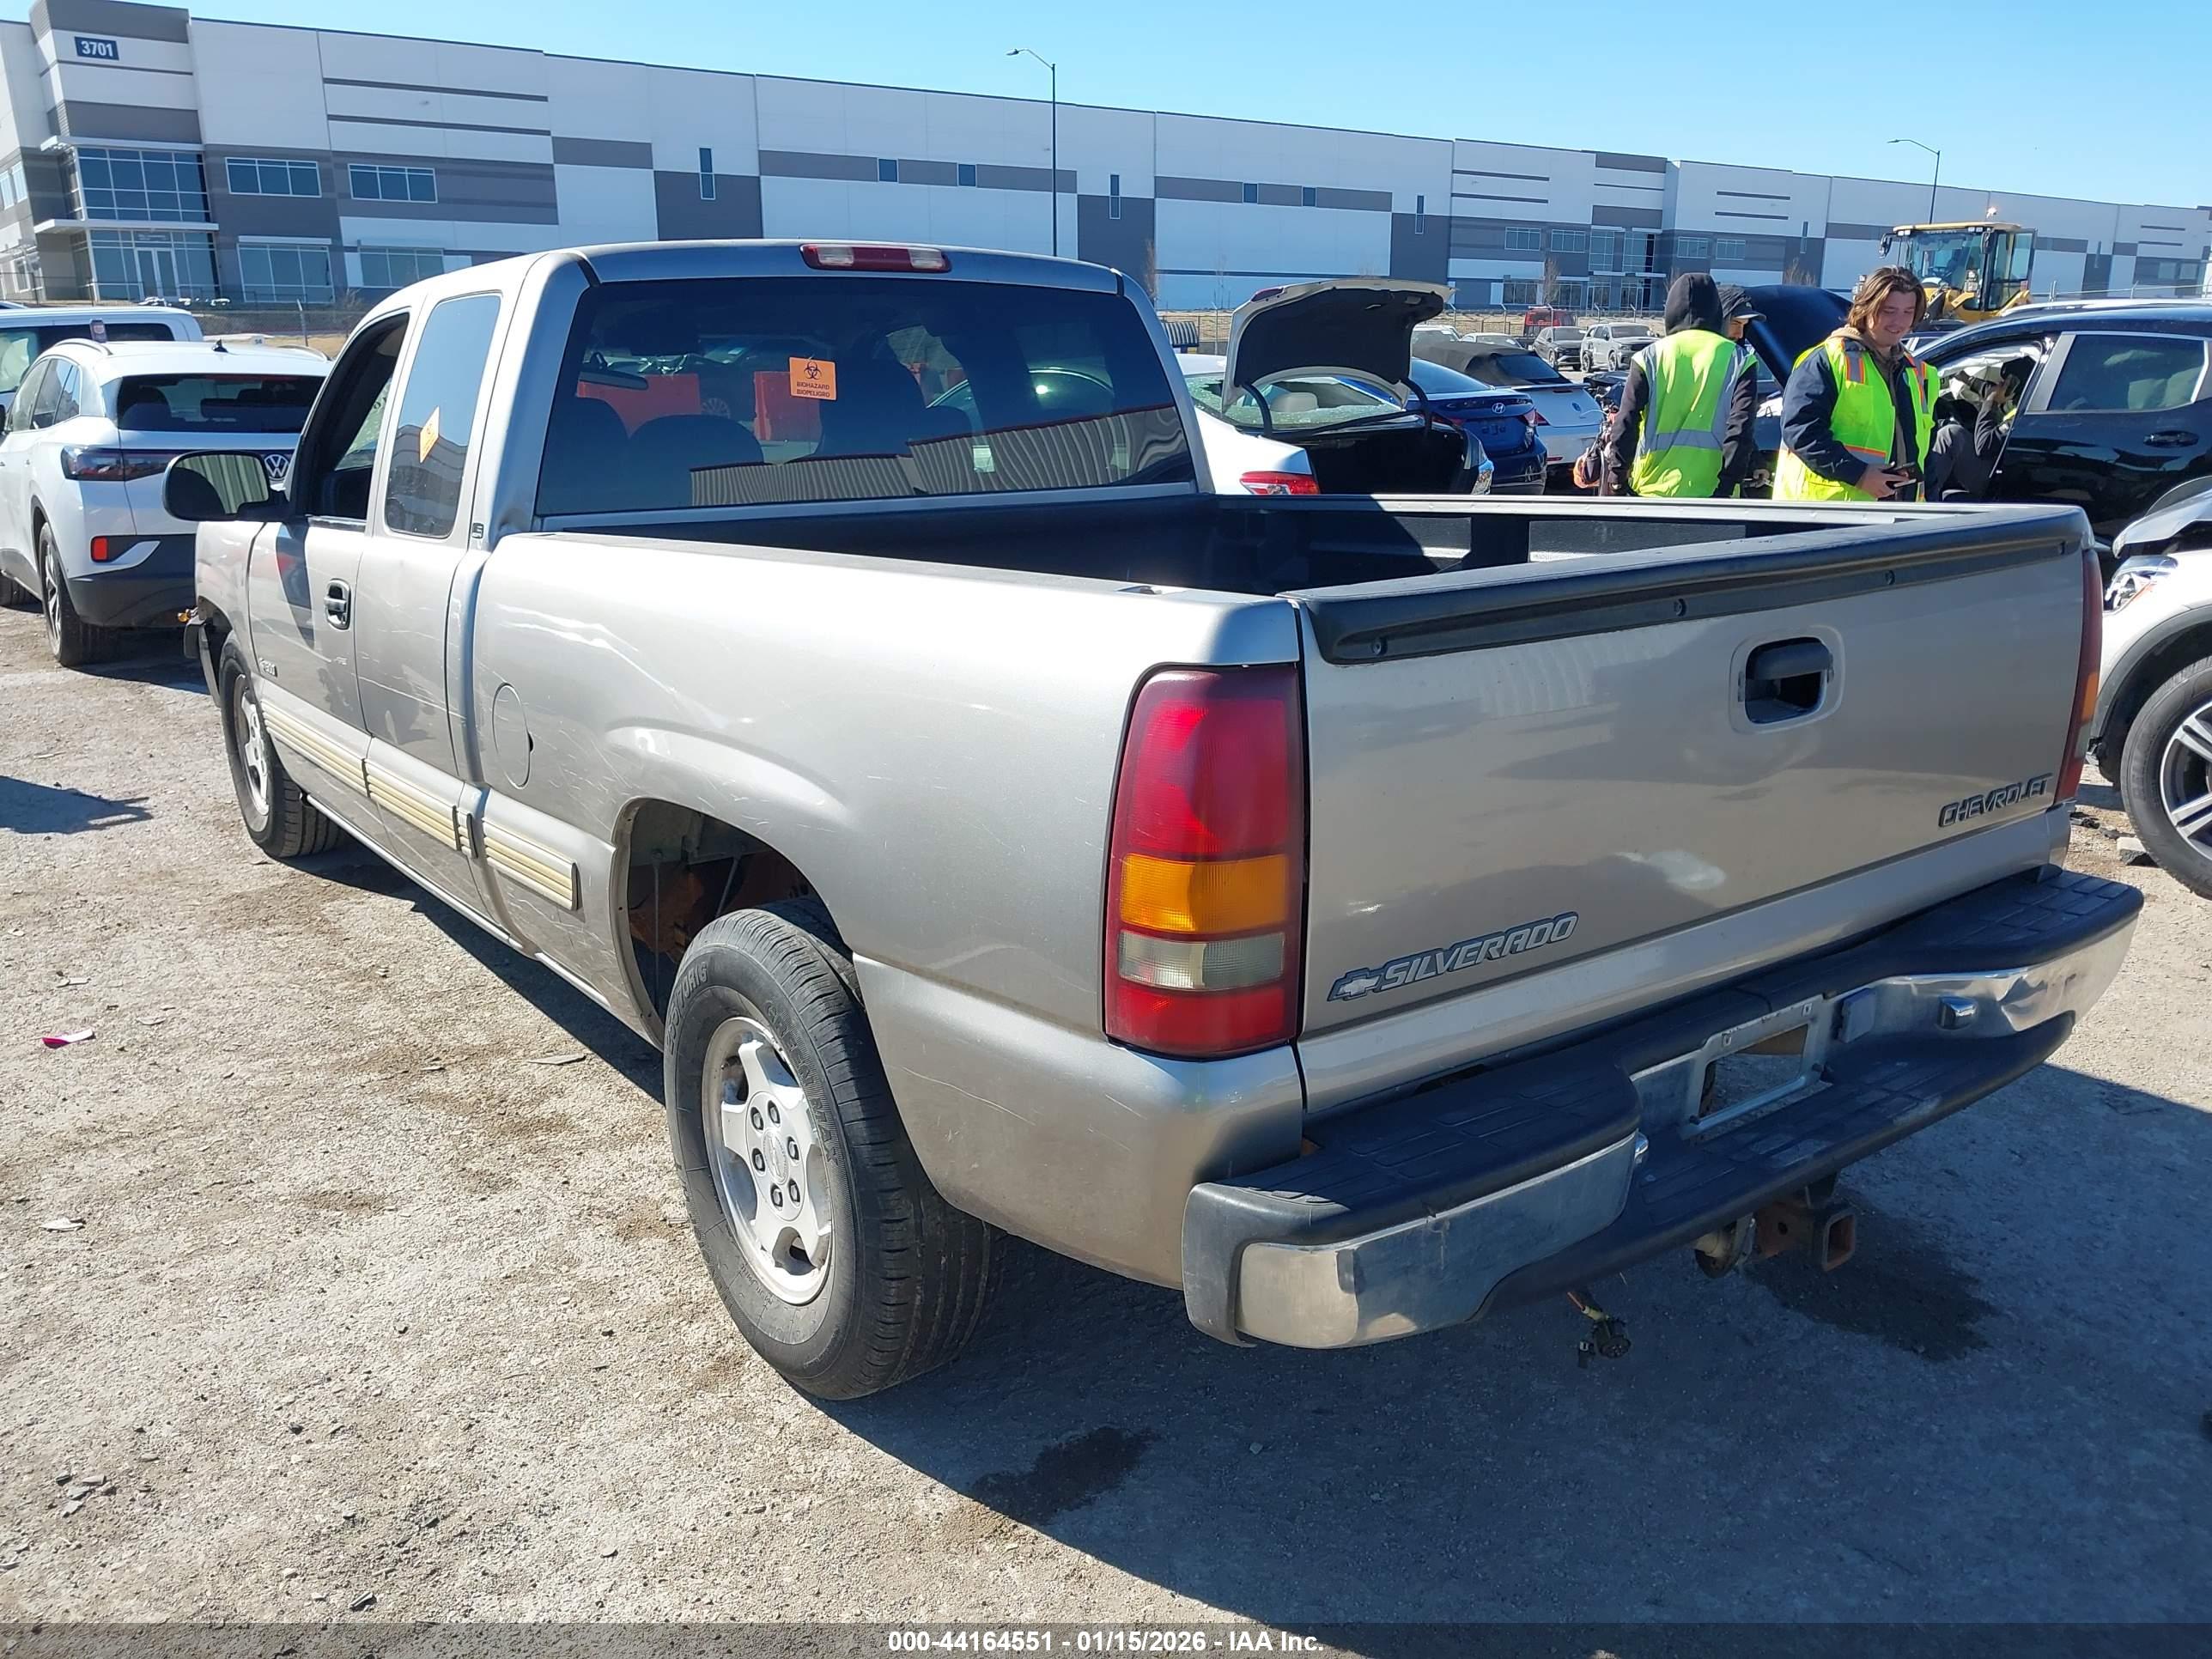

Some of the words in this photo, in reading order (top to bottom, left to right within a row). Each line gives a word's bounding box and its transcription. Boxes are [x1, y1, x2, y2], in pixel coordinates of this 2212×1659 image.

[81, 40, 113, 57] 3701
[796, 381, 830, 391] BIOHAZARD
[796, 389, 830, 398] BIOPELIGRO
[1939, 773, 2053, 827] CHEVROLET
[1376, 912, 1578, 993] SILVERADO
